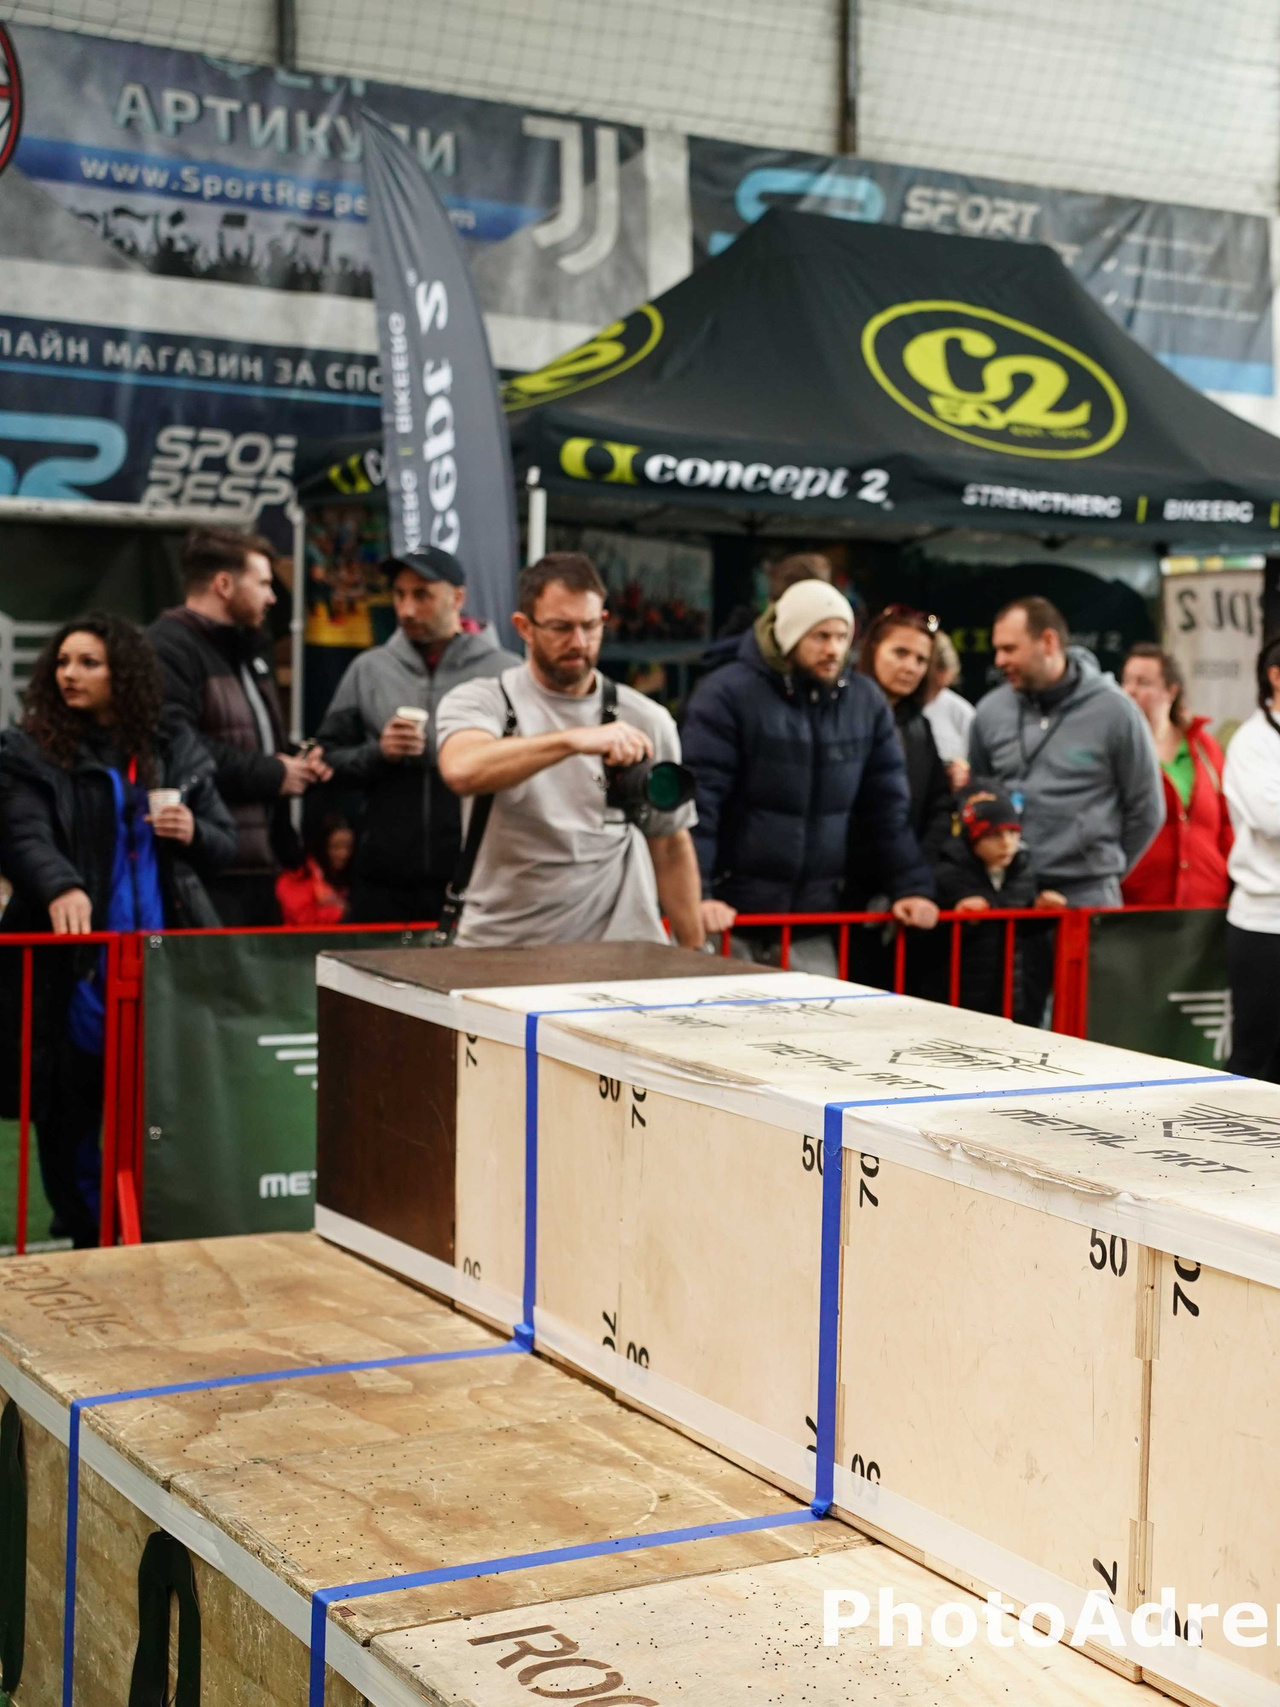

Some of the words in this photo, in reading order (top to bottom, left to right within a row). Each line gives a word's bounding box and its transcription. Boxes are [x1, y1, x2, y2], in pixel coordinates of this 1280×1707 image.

[113, 82, 457, 177] АРТИКУИ
[102, 338, 265, 384] МАГАЗИН
[273, 356, 316, 388] ЗА
[645, 451, 849, 502] concept
[856, 468, 892, 505] 2
[962, 482, 1122, 518] STRENGTHERG
[1163, 498, 1255, 524] BIKEERG
[746, 1042, 864, 1073] METAL
[853, 1071, 946, 1091] ART
[986, 1108, 1137, 1150] METAL
[1132, 1148, 1256, 1176] ART
[259, 1171, 317, 1199] ME
[859, 1152, 880, 1209] 70
[1090, 1227, 1128, 1278] 50
[1, 1261, 129, 1339] ROGUE
[1171, 1254, 1201, 1318] 70
[1092, 1557, 1118, 1605] 7
